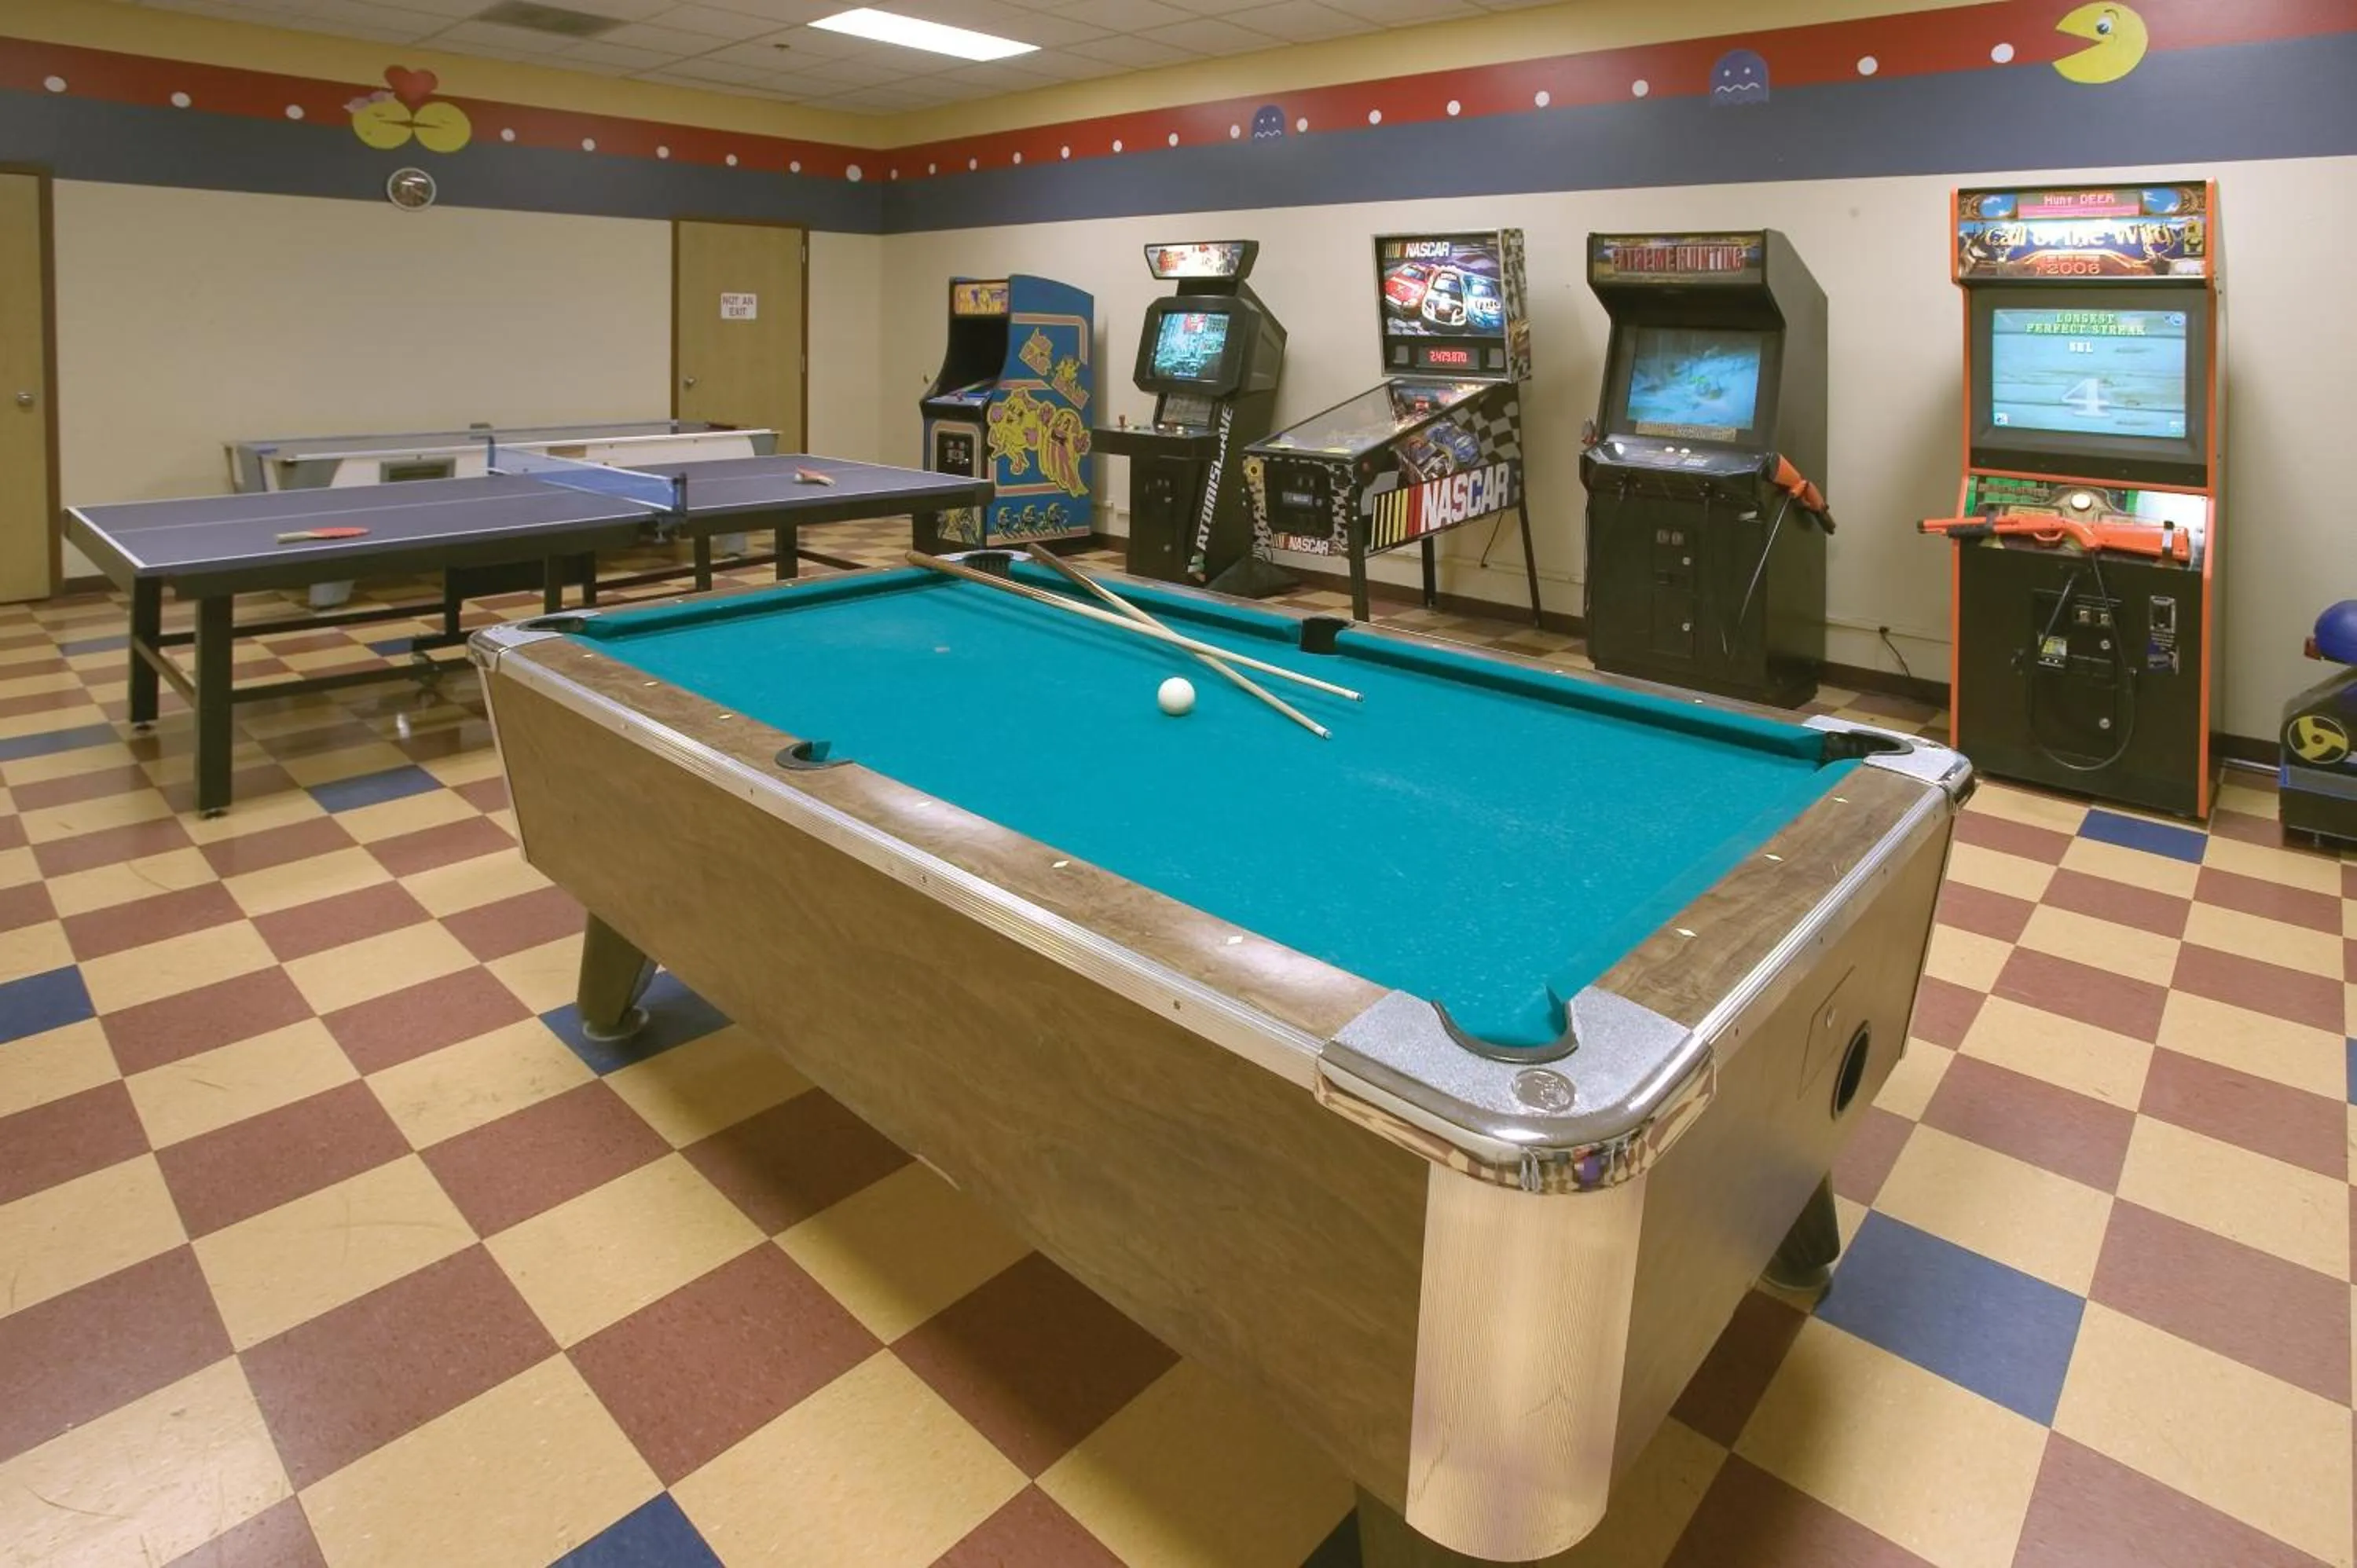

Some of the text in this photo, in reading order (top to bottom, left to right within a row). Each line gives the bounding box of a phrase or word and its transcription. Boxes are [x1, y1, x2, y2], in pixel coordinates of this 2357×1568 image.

[1405, 241, 1450, 258] NASCAR
[1677, 244, 1746, 272] HUNTING
[722, 296, 754, 306] NOT AN
[728, 306, 748, 317] EXIT
[2055, 313, 2115, 324] LONGEST
[2025, 323, 2088, 335] PERFECT
[2060, 377, 2113, 418] 4
[1420, 461, 1509, 534] NASCAR
[1288, 536, 1330, 556] NASCAR
